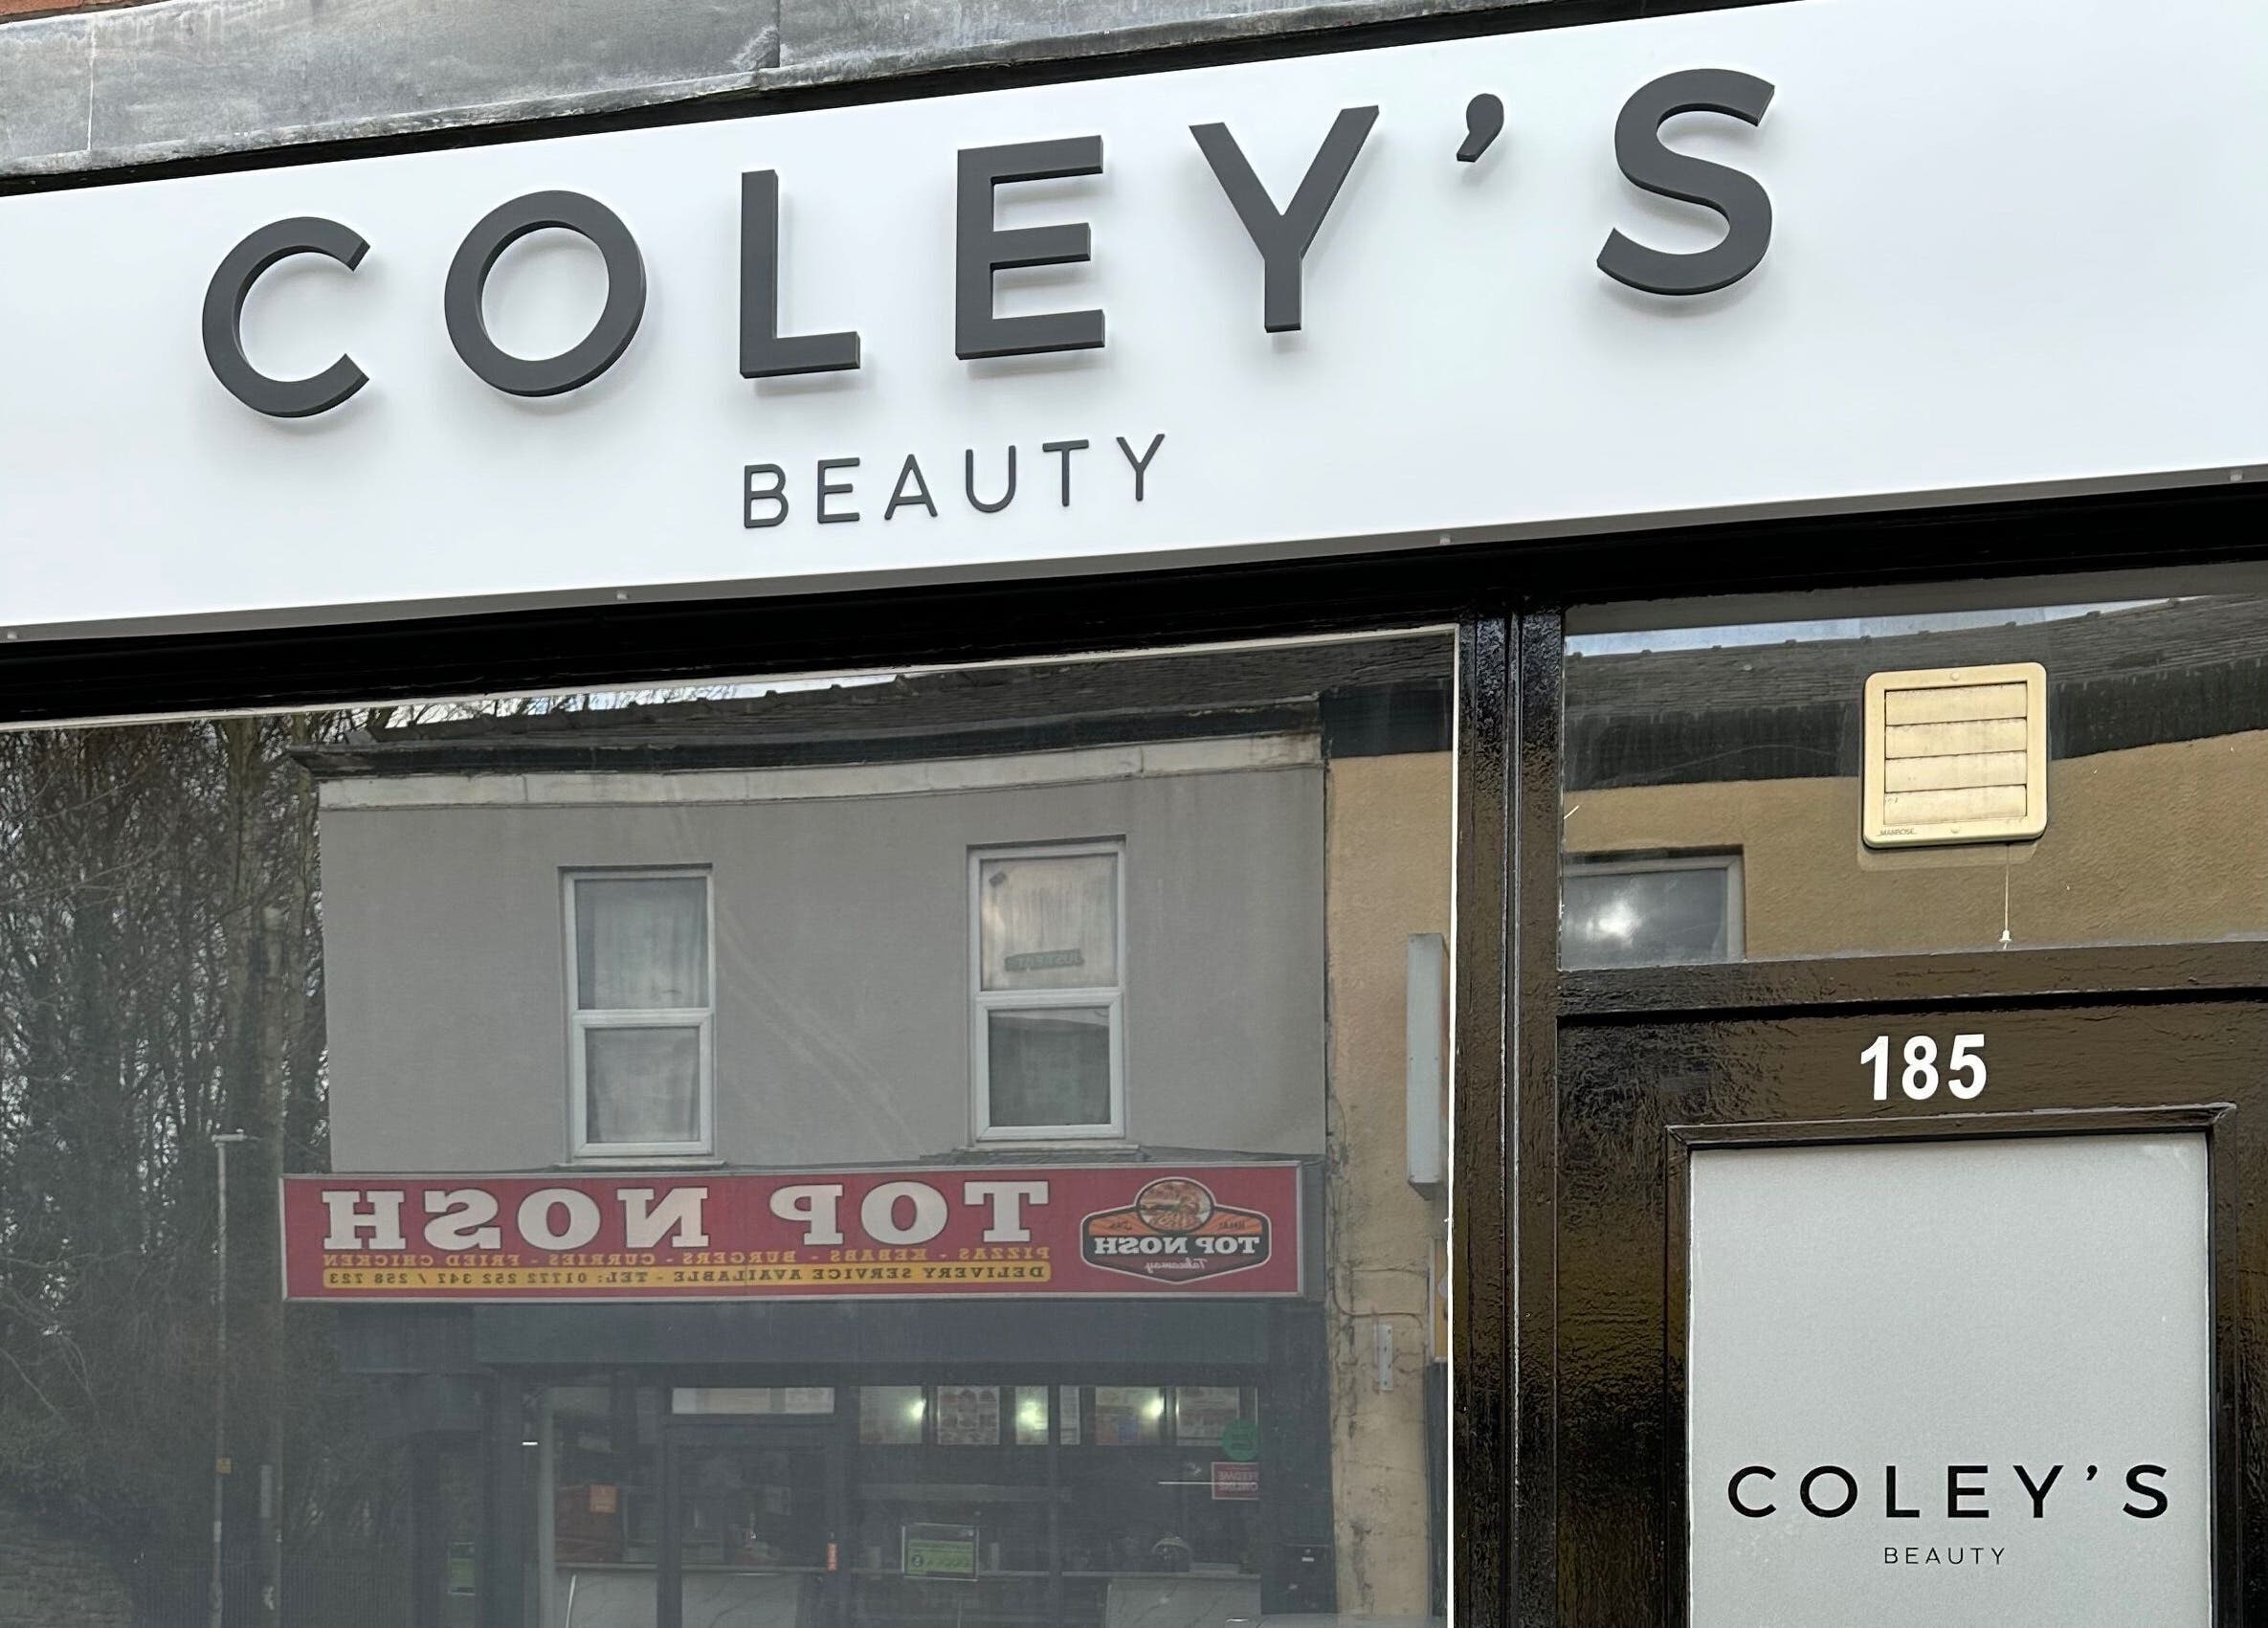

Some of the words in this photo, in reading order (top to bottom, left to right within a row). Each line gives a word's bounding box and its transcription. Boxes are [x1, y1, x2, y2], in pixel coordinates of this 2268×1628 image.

[202, 68, 1775, 418] COLEY'S
[744, 434, 1166, 529] BEAUTY
[1860, 1034, 1987, 1102] 185
[1727, 1464, 2169, 1519] COLEY'S
[1883, 1547, 2006, 1566] BEAUTY
